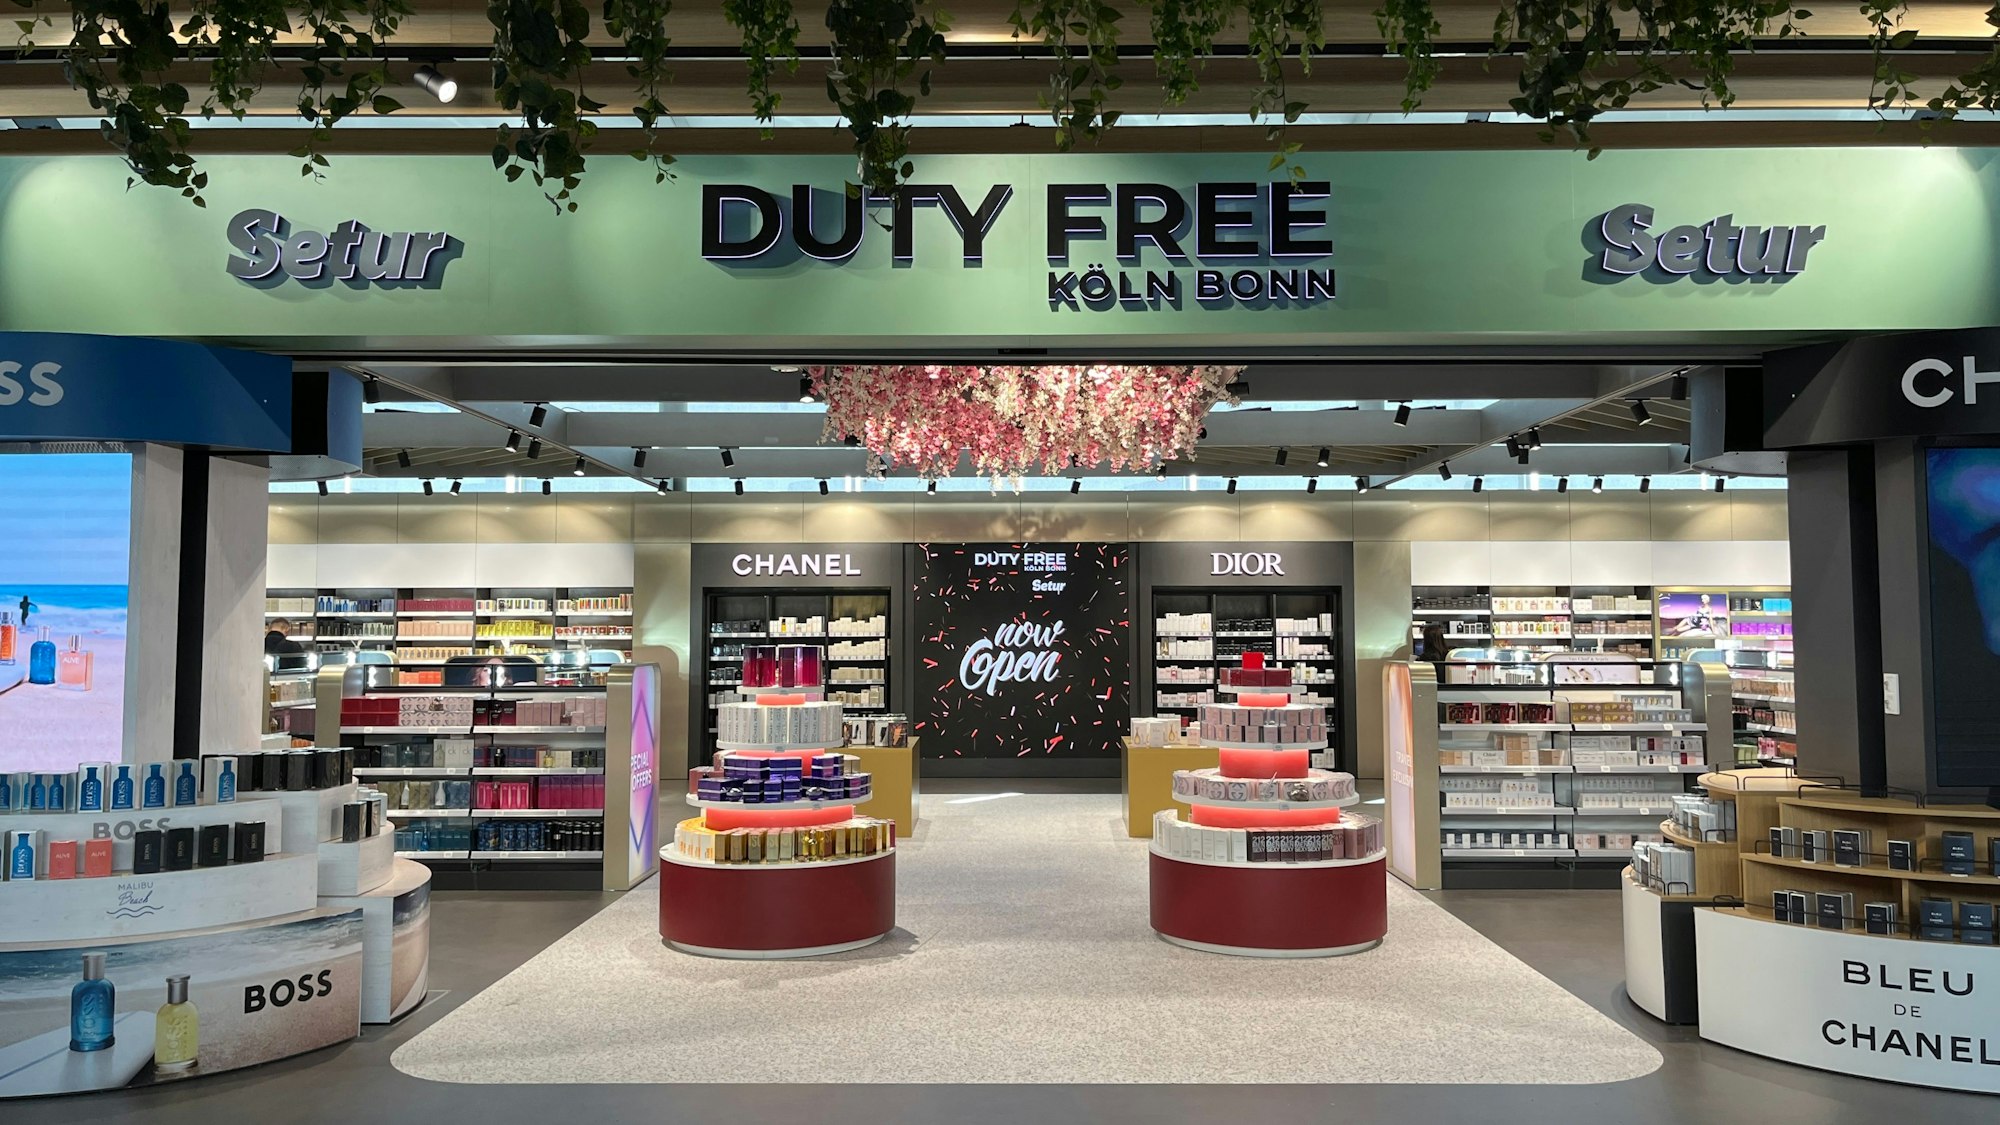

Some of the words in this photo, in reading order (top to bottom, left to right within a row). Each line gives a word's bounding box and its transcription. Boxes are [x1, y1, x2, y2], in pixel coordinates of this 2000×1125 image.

[701, 184, 1013, 260] DUTY
[1046, 181, 1334, 260] FREE
[226, 208, 449, 281] Setur
[1602, 203, 1827, 275] Setur
[1048, 263, 1176, 301] KÖLN
[1195, 268, 1337, 300] BONN
[0, 360, 64, 407] SS
[731, 553, 861, 576] CHANEL
[974, 552, 1020, 566] DUTY
[1023, 553, 1067, 566] FREE
[1210, 552, 1286, 576] DIOR
[1032, 579, 1067, 592] Setur
[994, 620, 1065, 648] now
[959, 638, 1061, 697] Open
[632, 769, 652, 791] OFFERS
[17, 848, 25, 874] BOSS
[118, 882, 154, 891] MALIBU
[118, 890, 153, 906] Beach
[1843, 959, 1974, 996] BLEU
[244, 969, 333, 1015] BOSS
[1894, 1003, 1922, 1018] DE
[1822, 1019, 2000, 1066] CHANEL
